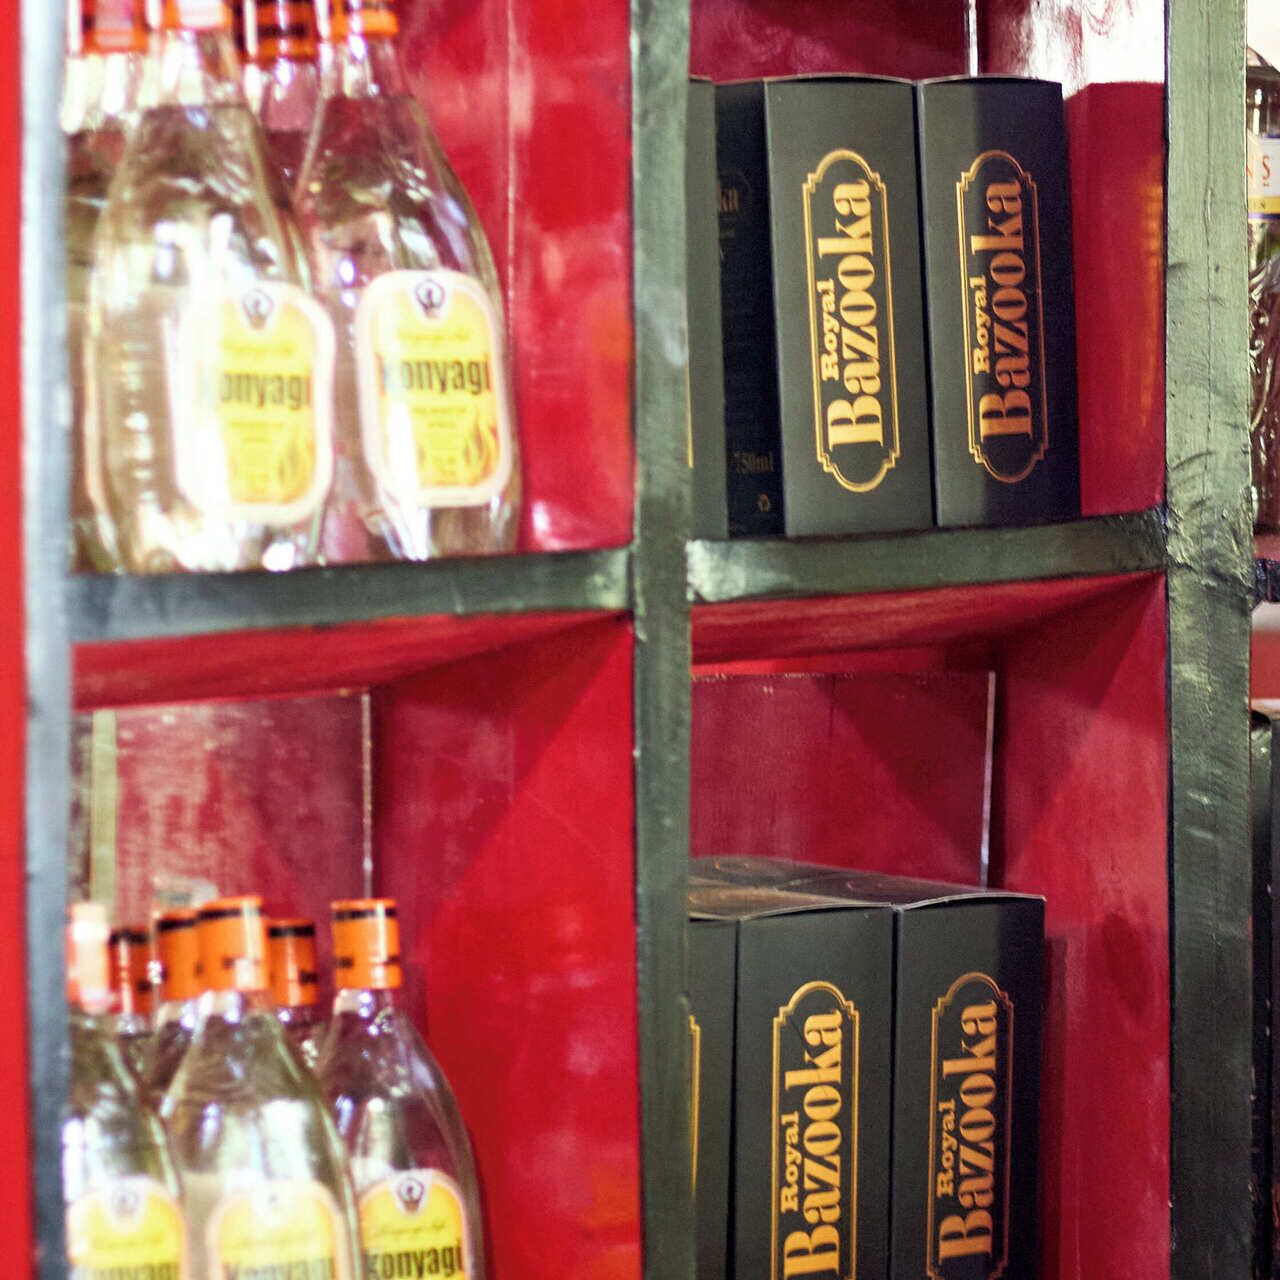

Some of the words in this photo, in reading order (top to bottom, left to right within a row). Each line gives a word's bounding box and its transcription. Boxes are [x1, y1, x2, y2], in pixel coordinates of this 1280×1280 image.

[818, 178, 884, 450] Bazooka
[820, 277, 841, 381] Royal
[970, 179, 1033, 442] Bazooka
[972, 275, 991, 375] Royal
[200, 367, 311, 410] onyagi
[780, 1111, 800, 1214] Royal
[783, 1009, 844, 1280] Bazooka
[937, 1099, 957, 1199] Royal
[938, 999, 998, 1265] Bazooka
